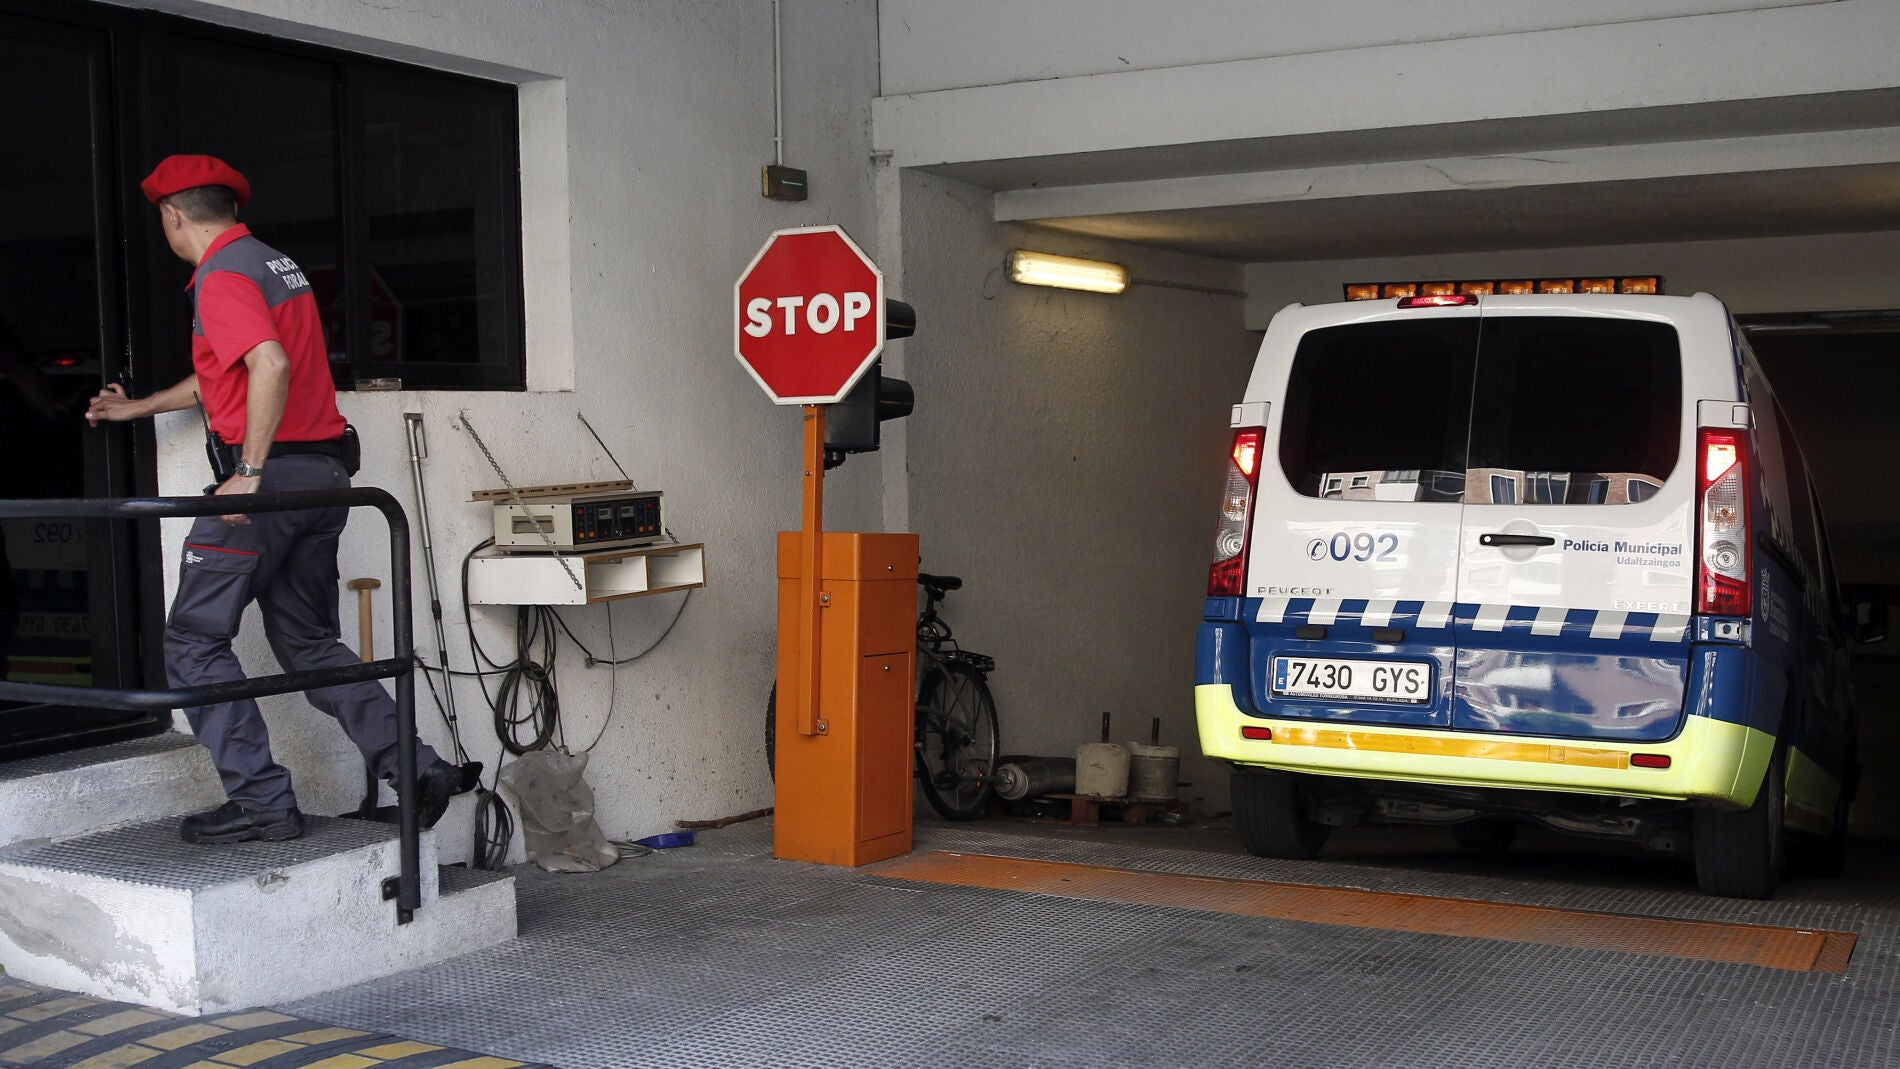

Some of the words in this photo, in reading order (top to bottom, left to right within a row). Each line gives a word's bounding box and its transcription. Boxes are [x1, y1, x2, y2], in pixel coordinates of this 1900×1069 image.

[743, 291, 872, 338] STOP
[1329, 532, 1399, 562] 092
[1563, 539, 1609, 552] Policía
[1614, 541, 1683, 556] Municipal
[1616, 556, 1681, 568] Udaltzaingoa
[1257, 586, 1334, 596] PEUGEOT
[1613, 600, 1681, 612] EXPERT
[1278, 677, 1285, 685] E
[1291, 662, 1353, 690] 7430
[1372, 667, 1420, 694] GYS
